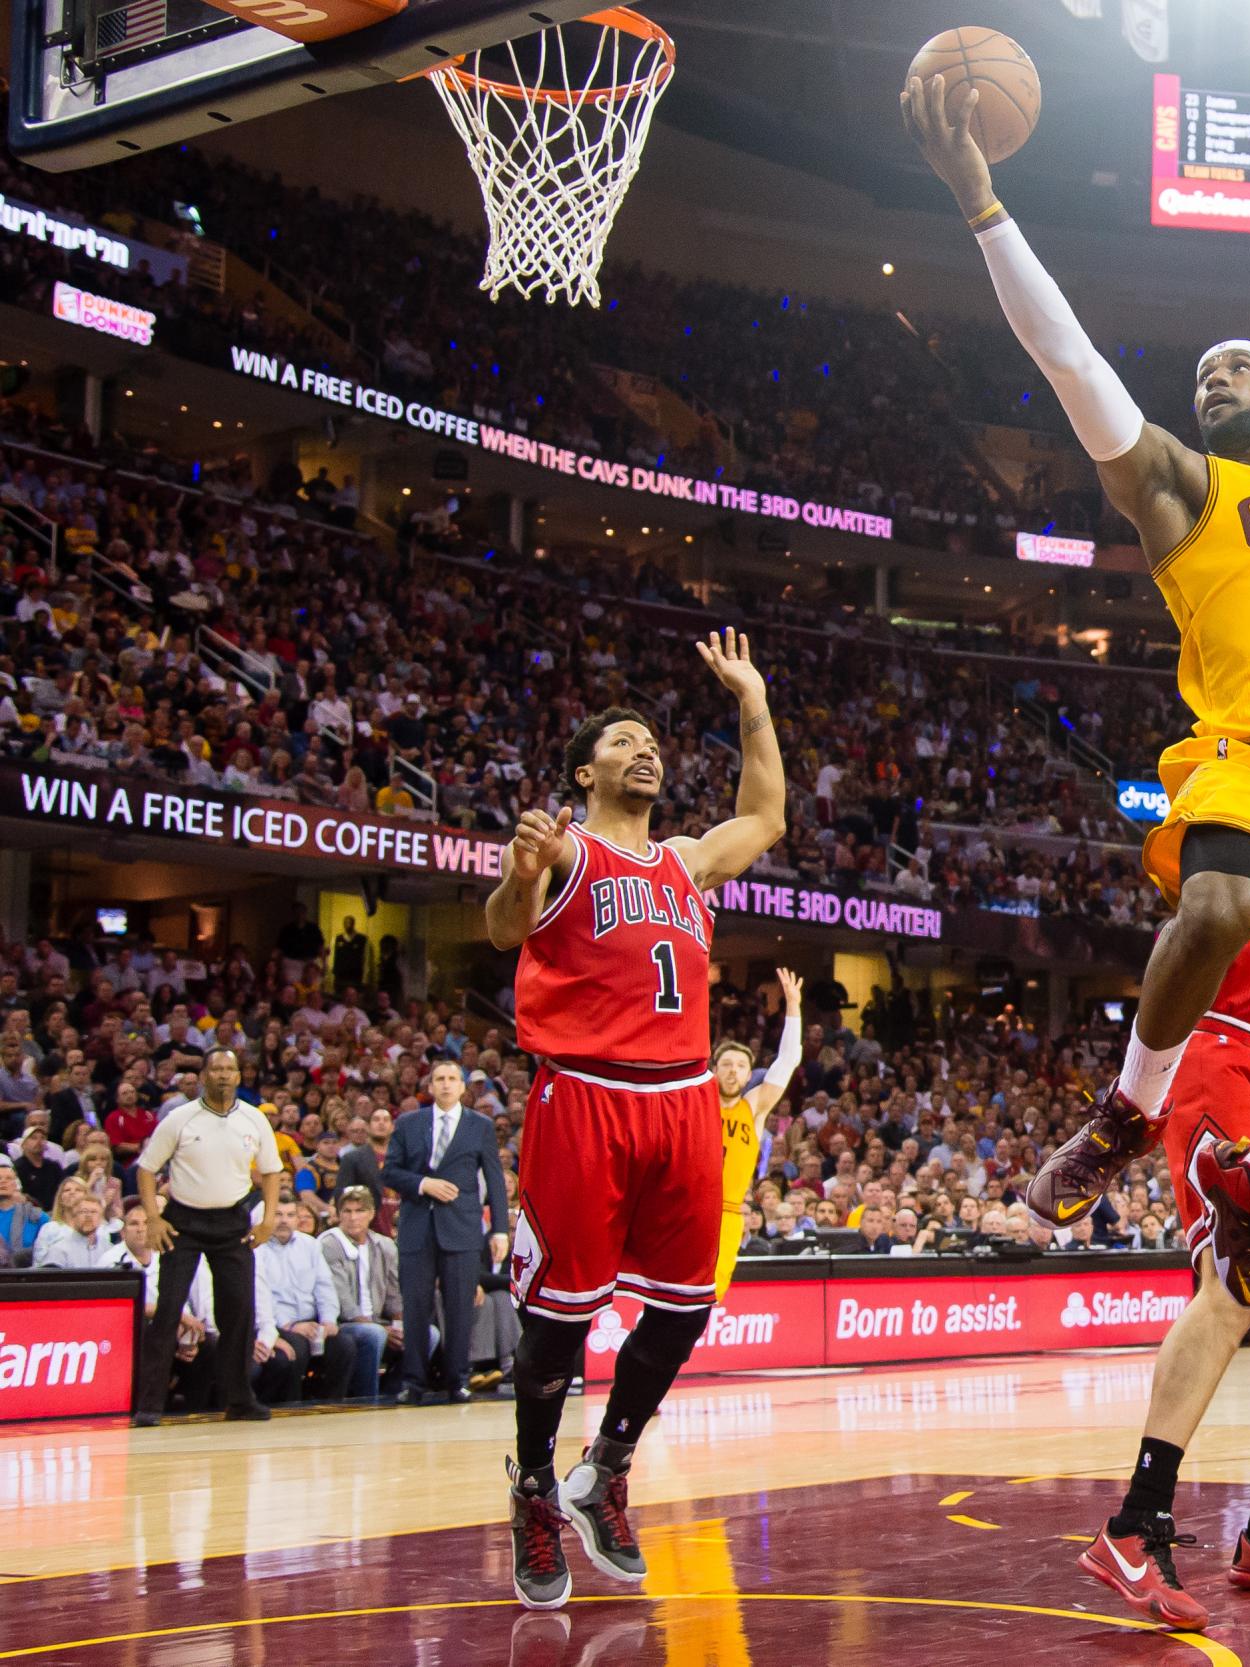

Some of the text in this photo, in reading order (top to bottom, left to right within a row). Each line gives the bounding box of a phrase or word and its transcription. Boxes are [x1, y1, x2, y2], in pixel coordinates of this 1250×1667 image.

[1156, 105, 1177, 151] CAVS
[83, 311, 153, 345] DONUTS
[231, 346, 278, 382] WIN
[281, 363, 298, 389] A
[302, 368, 353, 405] FREE
[356, 385, 404, 421] ICED
[406, 403, 479, 445] COFFEE
[480, 424, 538, 464] WHEN
[538, 442, 577, 475] THE
[577, 455, 630, 488] CAVS
[632, 467, 694, 501] DUNK
[694, 479, 718, 505] IN
[718, 484, 759, 514] THE
[761, 494, 800, 521] 3RD
[1119, 785, 1171, 818] drug
[21, 773, 97, 819] WIN
[106, 788, 133, 824] A
[142, 792, 223, 837] FREE
[232, 805, 308, 849] ICED
[314, 818, 428, 866] COFFEE
[723, 879, 748, 912] IN
[750, 882, 795, 918] THE
[797, 889, 841, 924] 3RD
[591, 876, 710, 953] BULLS
[651, 941, 683, 1014] 1
[695, 1306, 775, 1348] Farm
[836, 1296, 1022, 1339] Born to assist.
[0, 1333, 99, 1390] arm
